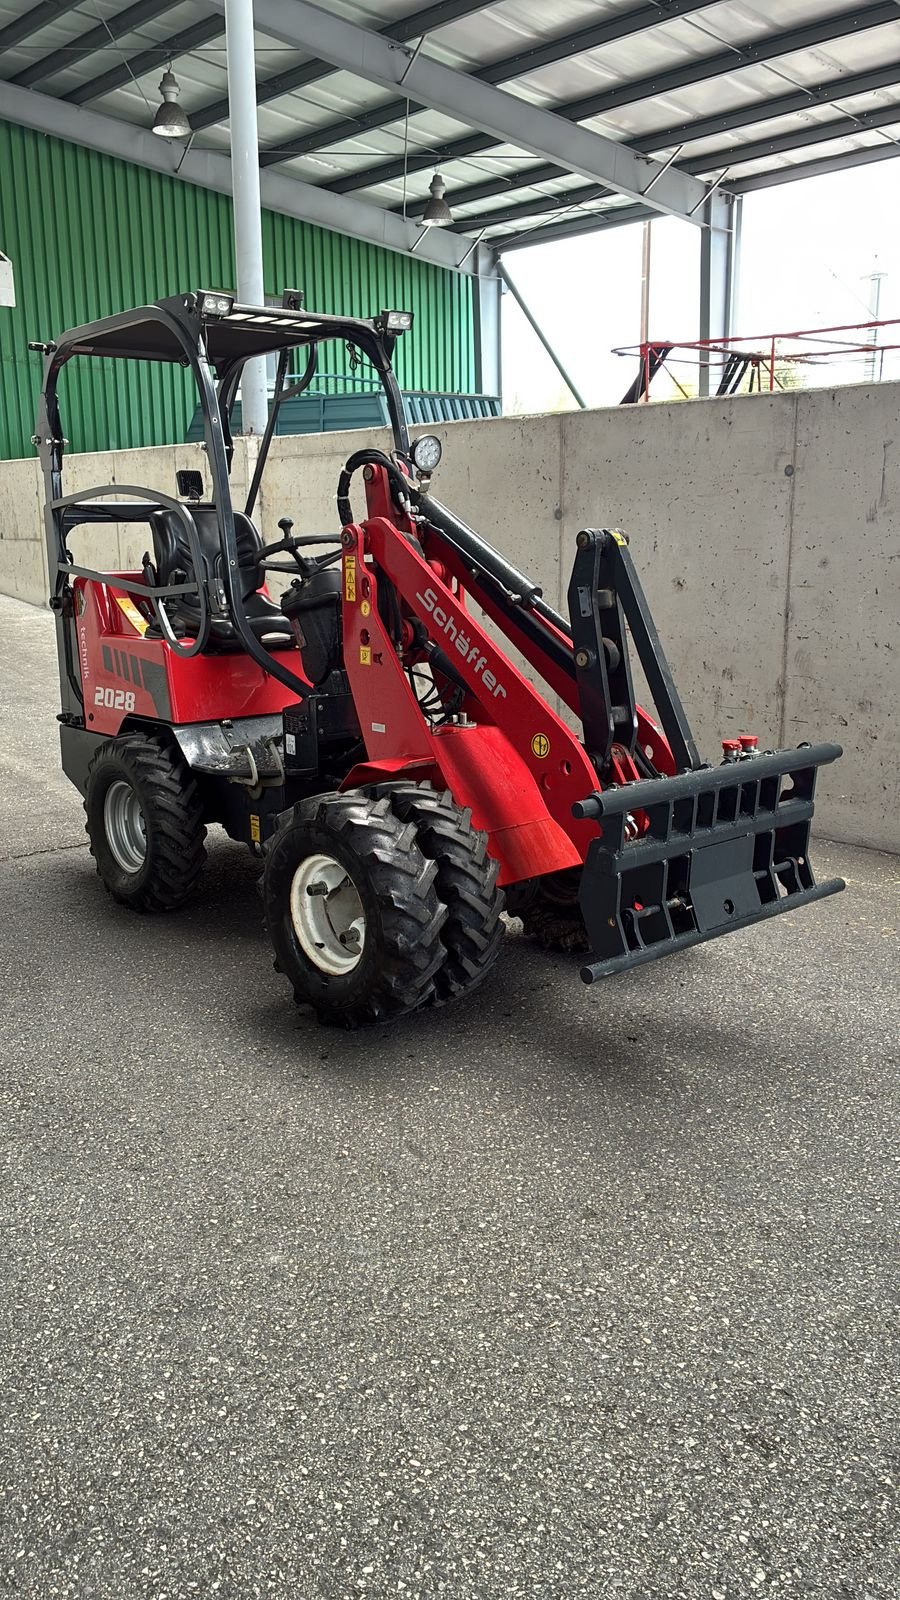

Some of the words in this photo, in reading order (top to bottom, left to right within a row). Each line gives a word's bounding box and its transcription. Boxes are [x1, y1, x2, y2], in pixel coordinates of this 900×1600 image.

[80, 626, 90, 679] technik
[415, 588, 507, 698] Schäffer
[94, 686, 136, 712] 2028
